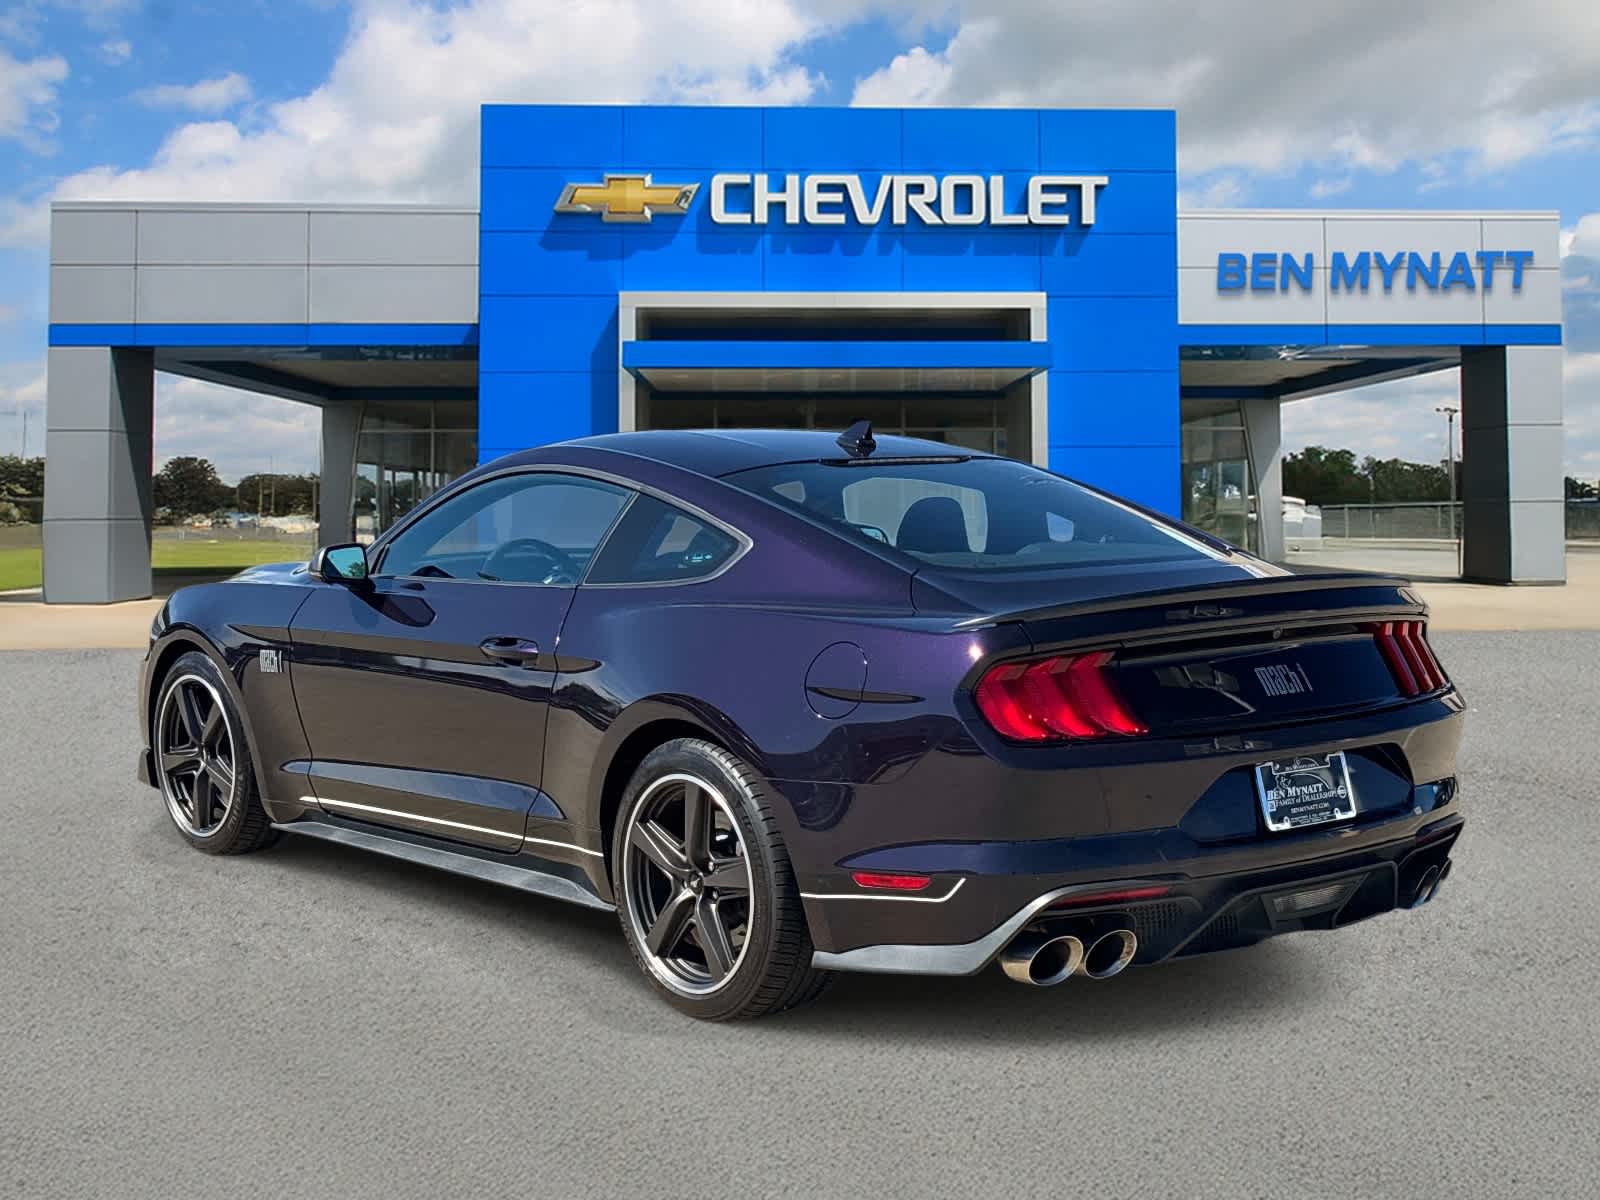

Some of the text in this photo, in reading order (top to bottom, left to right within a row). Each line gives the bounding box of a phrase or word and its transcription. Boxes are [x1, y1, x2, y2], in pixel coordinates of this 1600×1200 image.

[710, 173, 1109, 225] CHEVROLET
[1217, 250, 1534, 290] BEN MYNATT
[1267, 783, 1323, 800] BEN MYNATT
